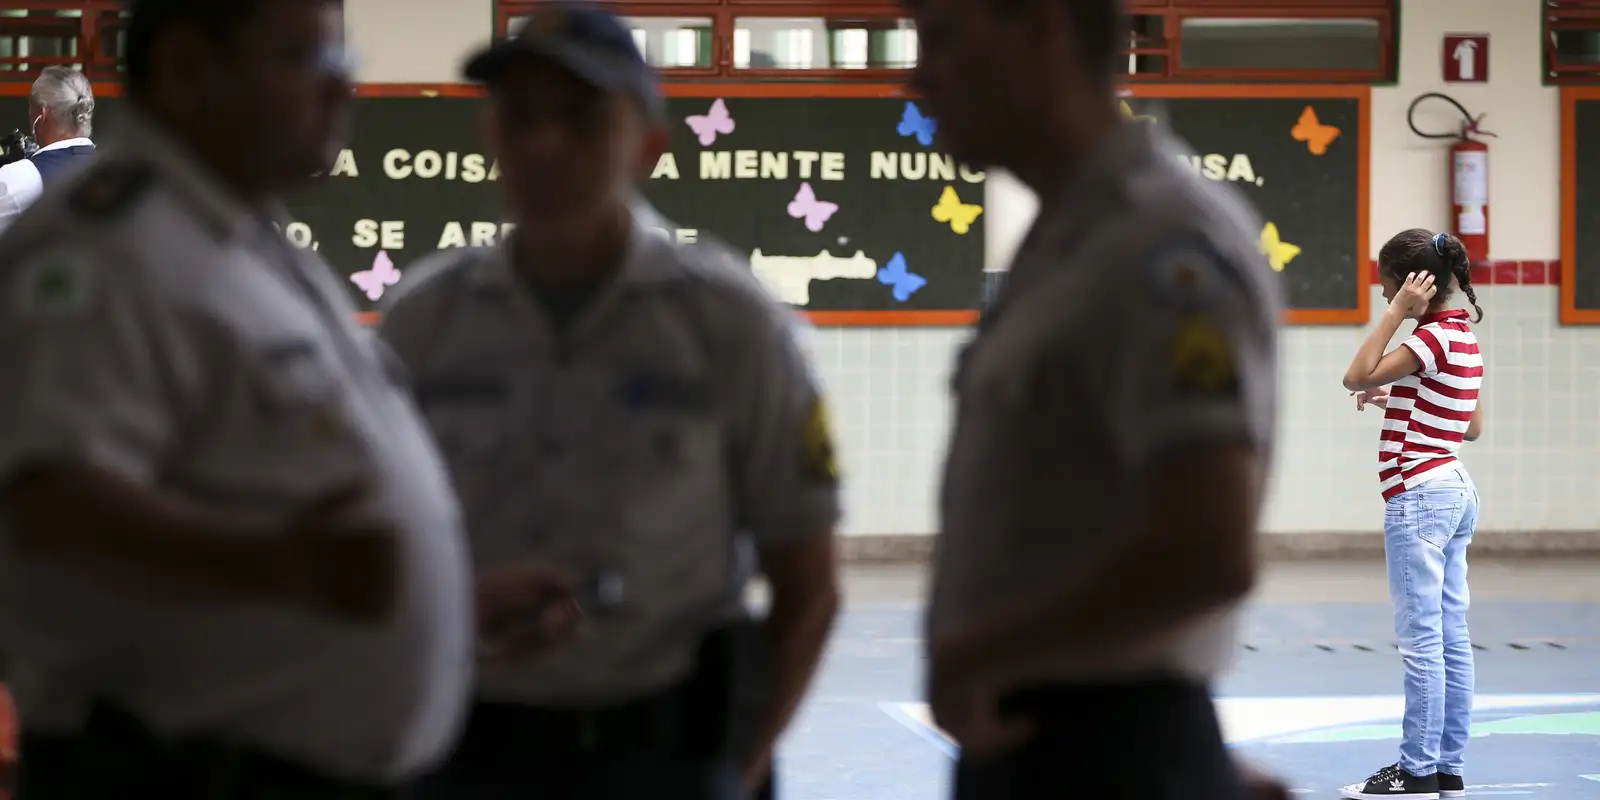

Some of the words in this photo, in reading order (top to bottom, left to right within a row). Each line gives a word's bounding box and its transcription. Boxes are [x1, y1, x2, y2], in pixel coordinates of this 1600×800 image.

[699, 149, 845, 180] MENTE
[870, 150, 986, 184] NUNC
[351, 218, 405, 249] SE
